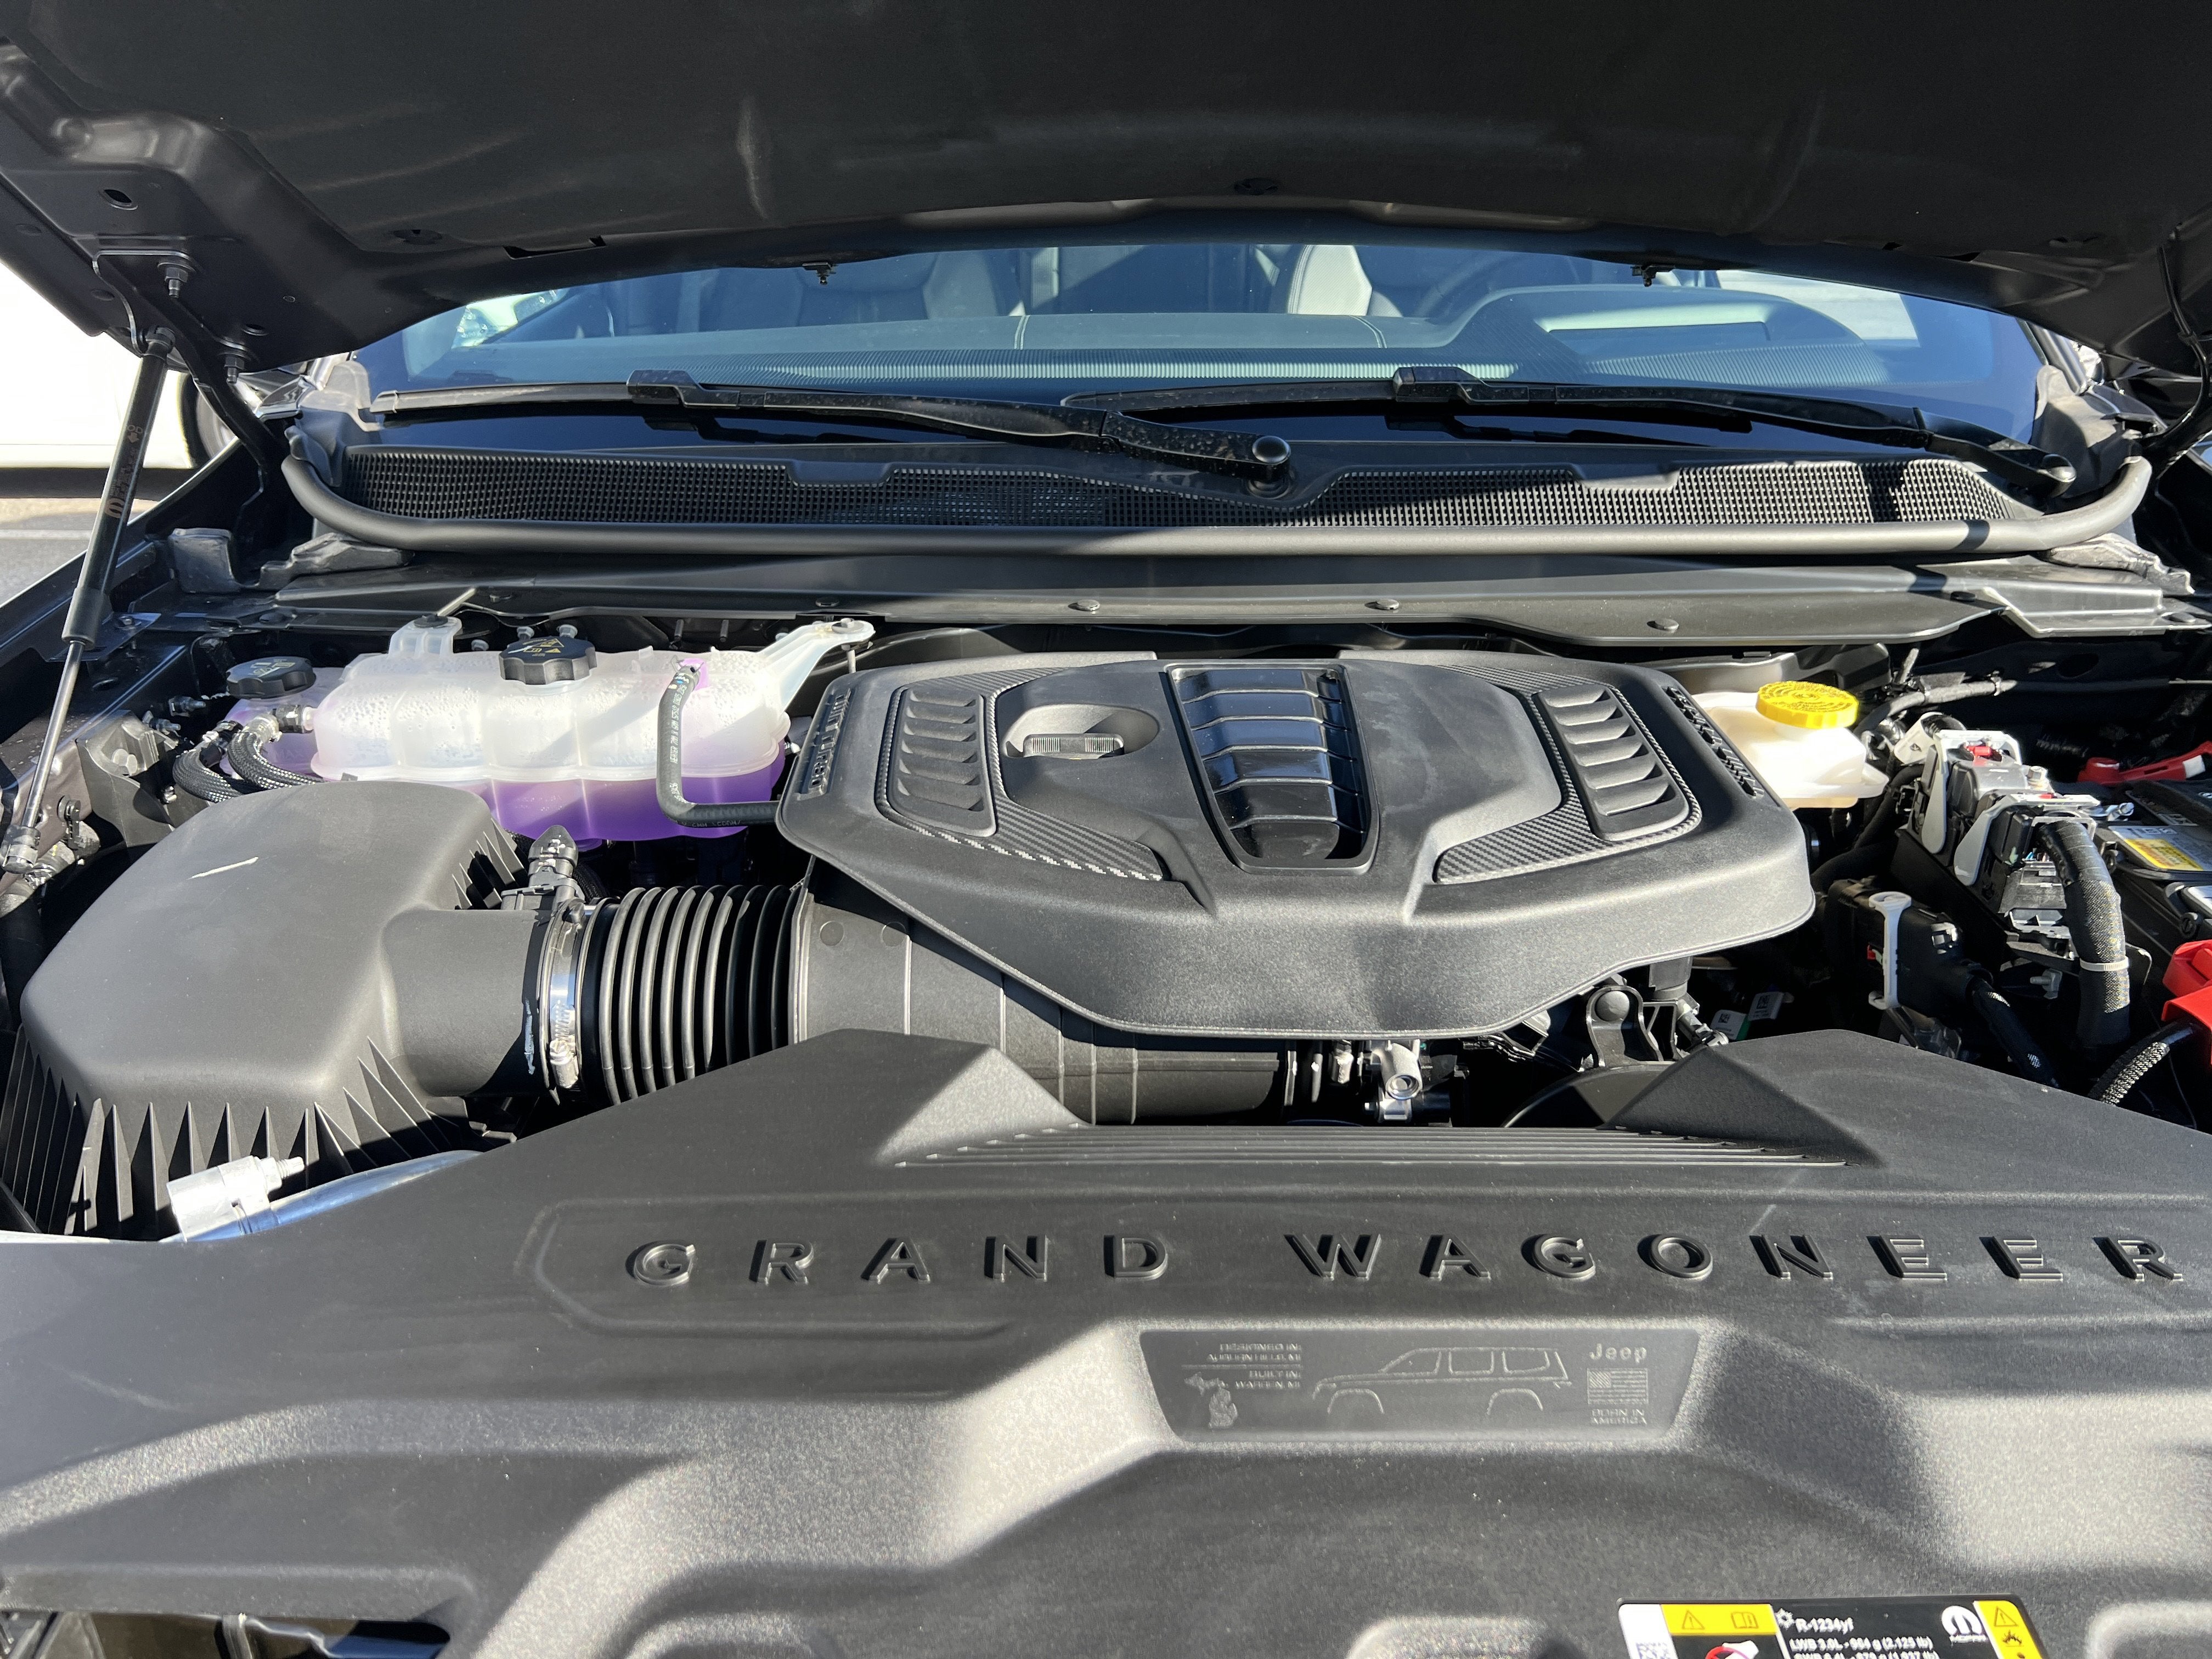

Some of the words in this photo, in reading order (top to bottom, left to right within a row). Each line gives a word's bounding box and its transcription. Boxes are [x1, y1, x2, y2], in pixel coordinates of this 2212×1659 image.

[627, 1234, 1168, 1286] GRAND
[1285, 1234, 2183, 1282] WAGONEER
[1589, 1343, 1646, 1363] Jeep
[1795, 1617, 1854, 1635] R-1234yf
